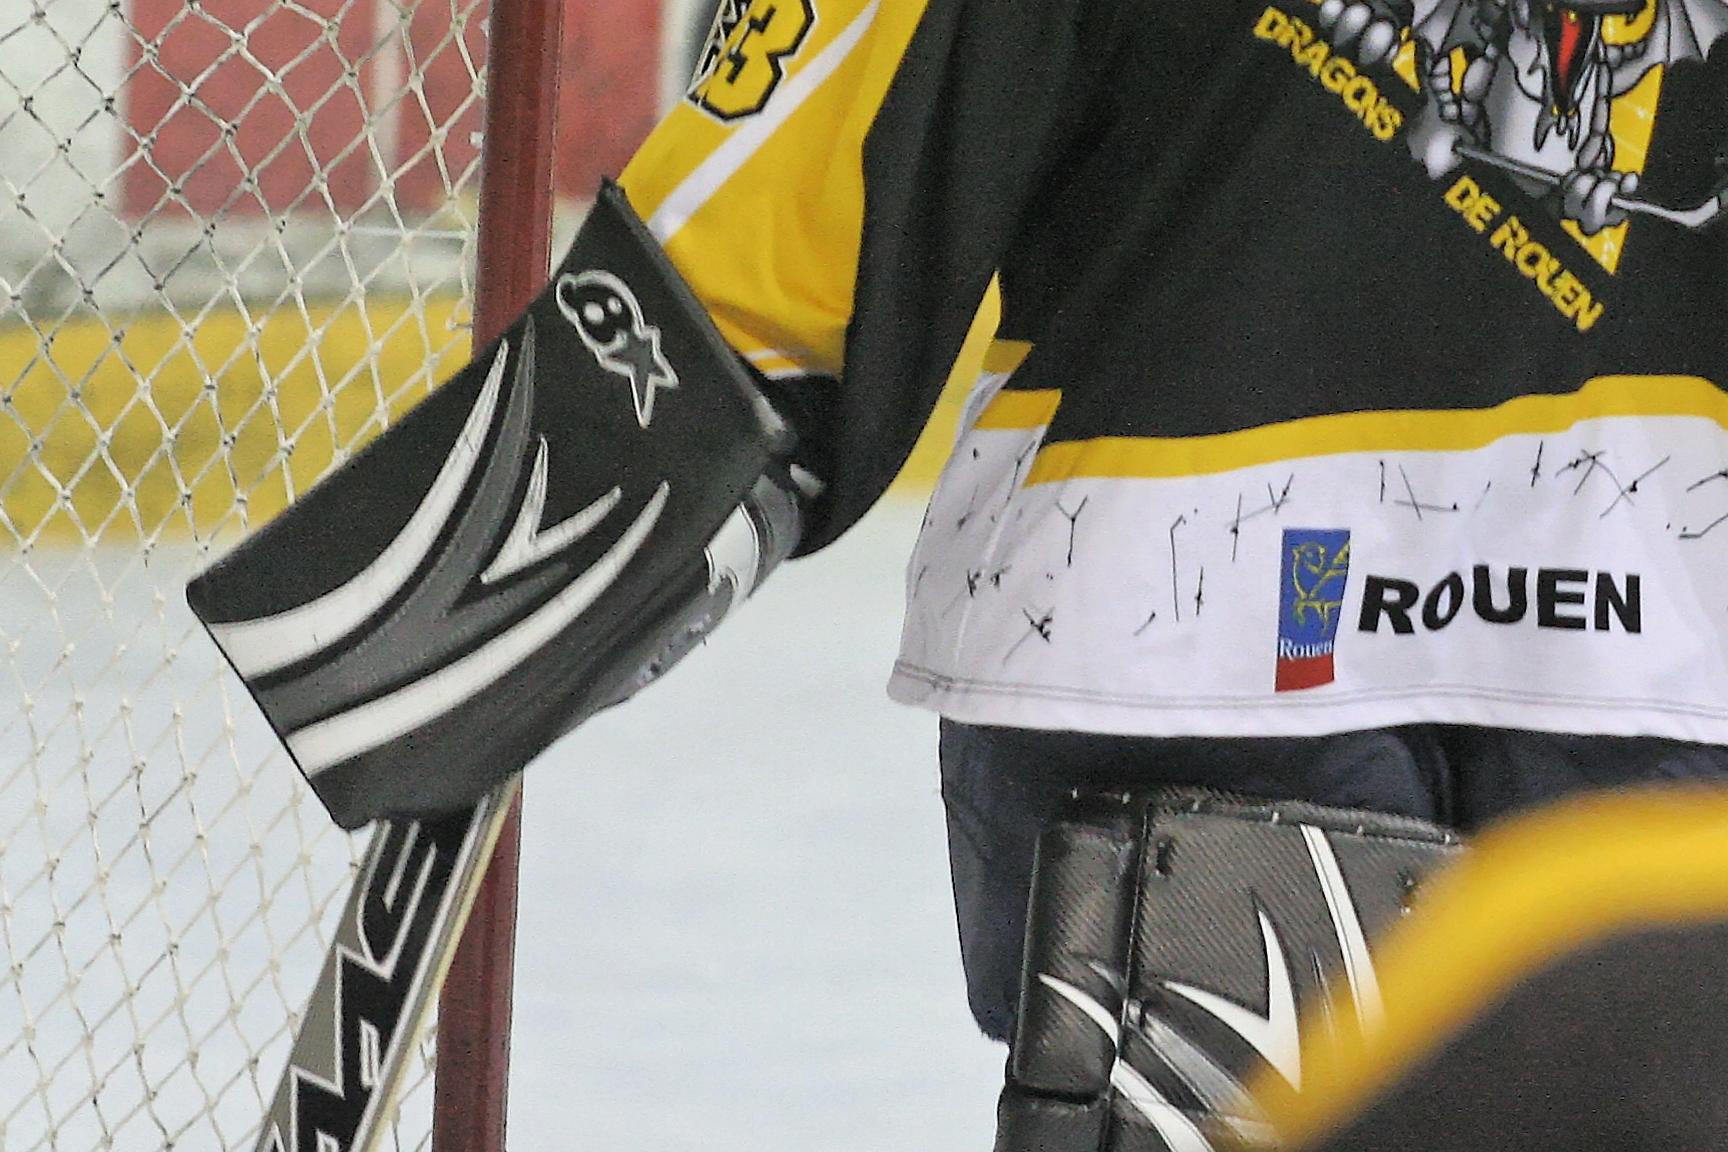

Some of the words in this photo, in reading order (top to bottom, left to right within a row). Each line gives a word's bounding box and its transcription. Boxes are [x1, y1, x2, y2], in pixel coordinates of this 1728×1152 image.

[1252, 5, 1404, 142] DRAGONS
[1443, 175, 1501, 233] DE
[1489, 214, 1605, 333] ROUEN
[1278, 636, 1334, 663] Rouen
[1357, 563, 1642, 635] ROUEN
